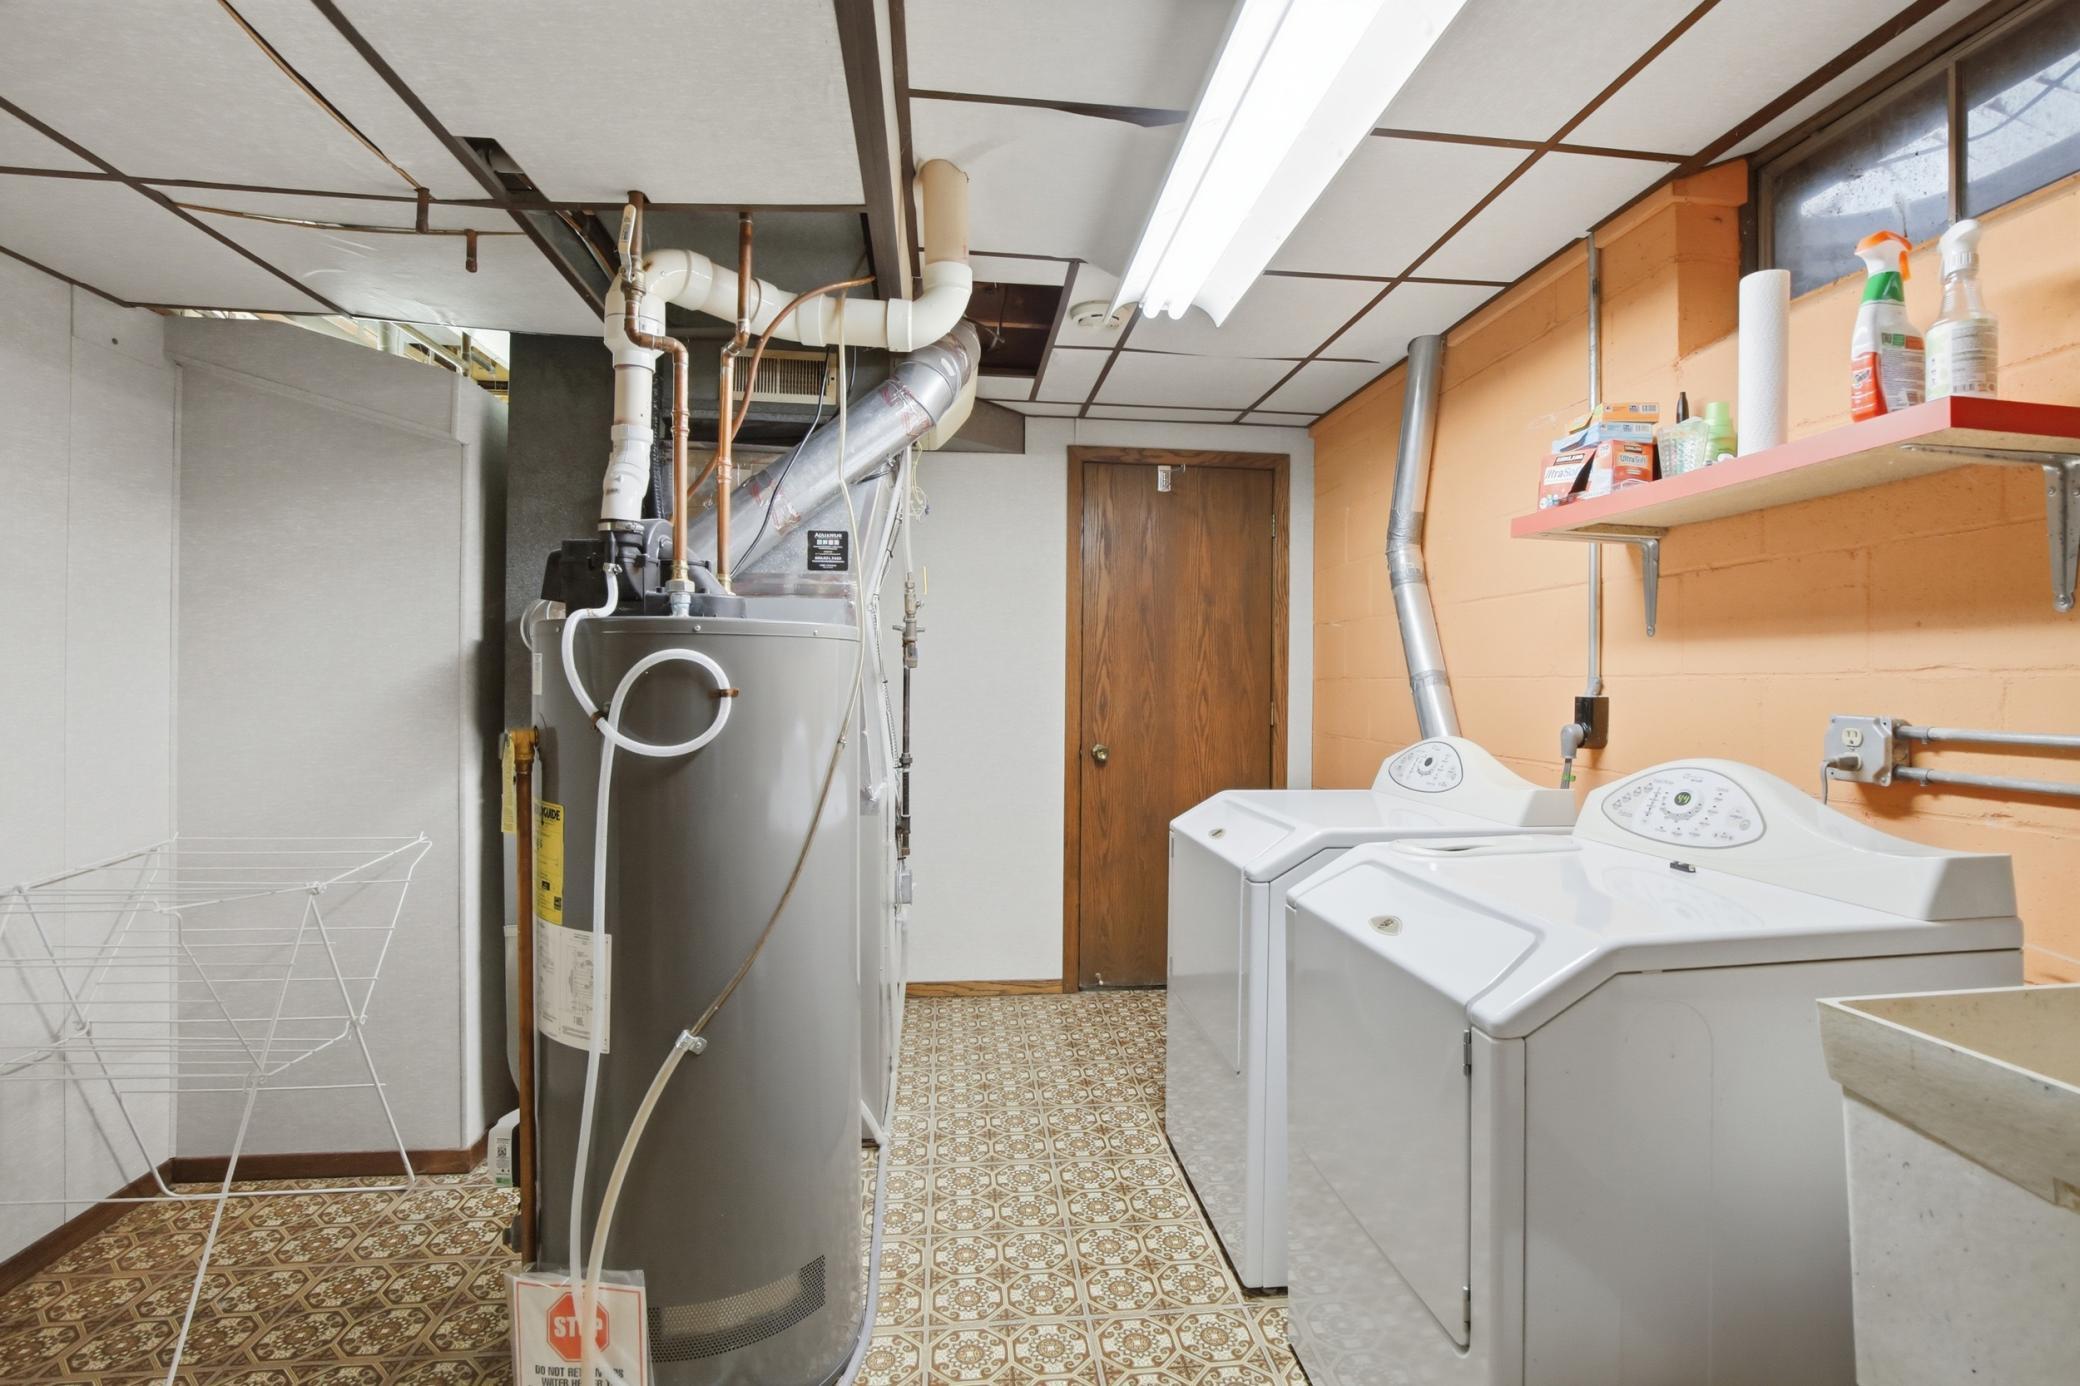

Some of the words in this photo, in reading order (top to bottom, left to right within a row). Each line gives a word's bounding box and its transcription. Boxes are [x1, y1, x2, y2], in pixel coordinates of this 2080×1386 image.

[554, 1316, 603, 1338] STP
[535, 1364, 546, 1375] DO
[547, 1365, 565, 1377] NOT
[567, 1367, 602, 1378] RETN
